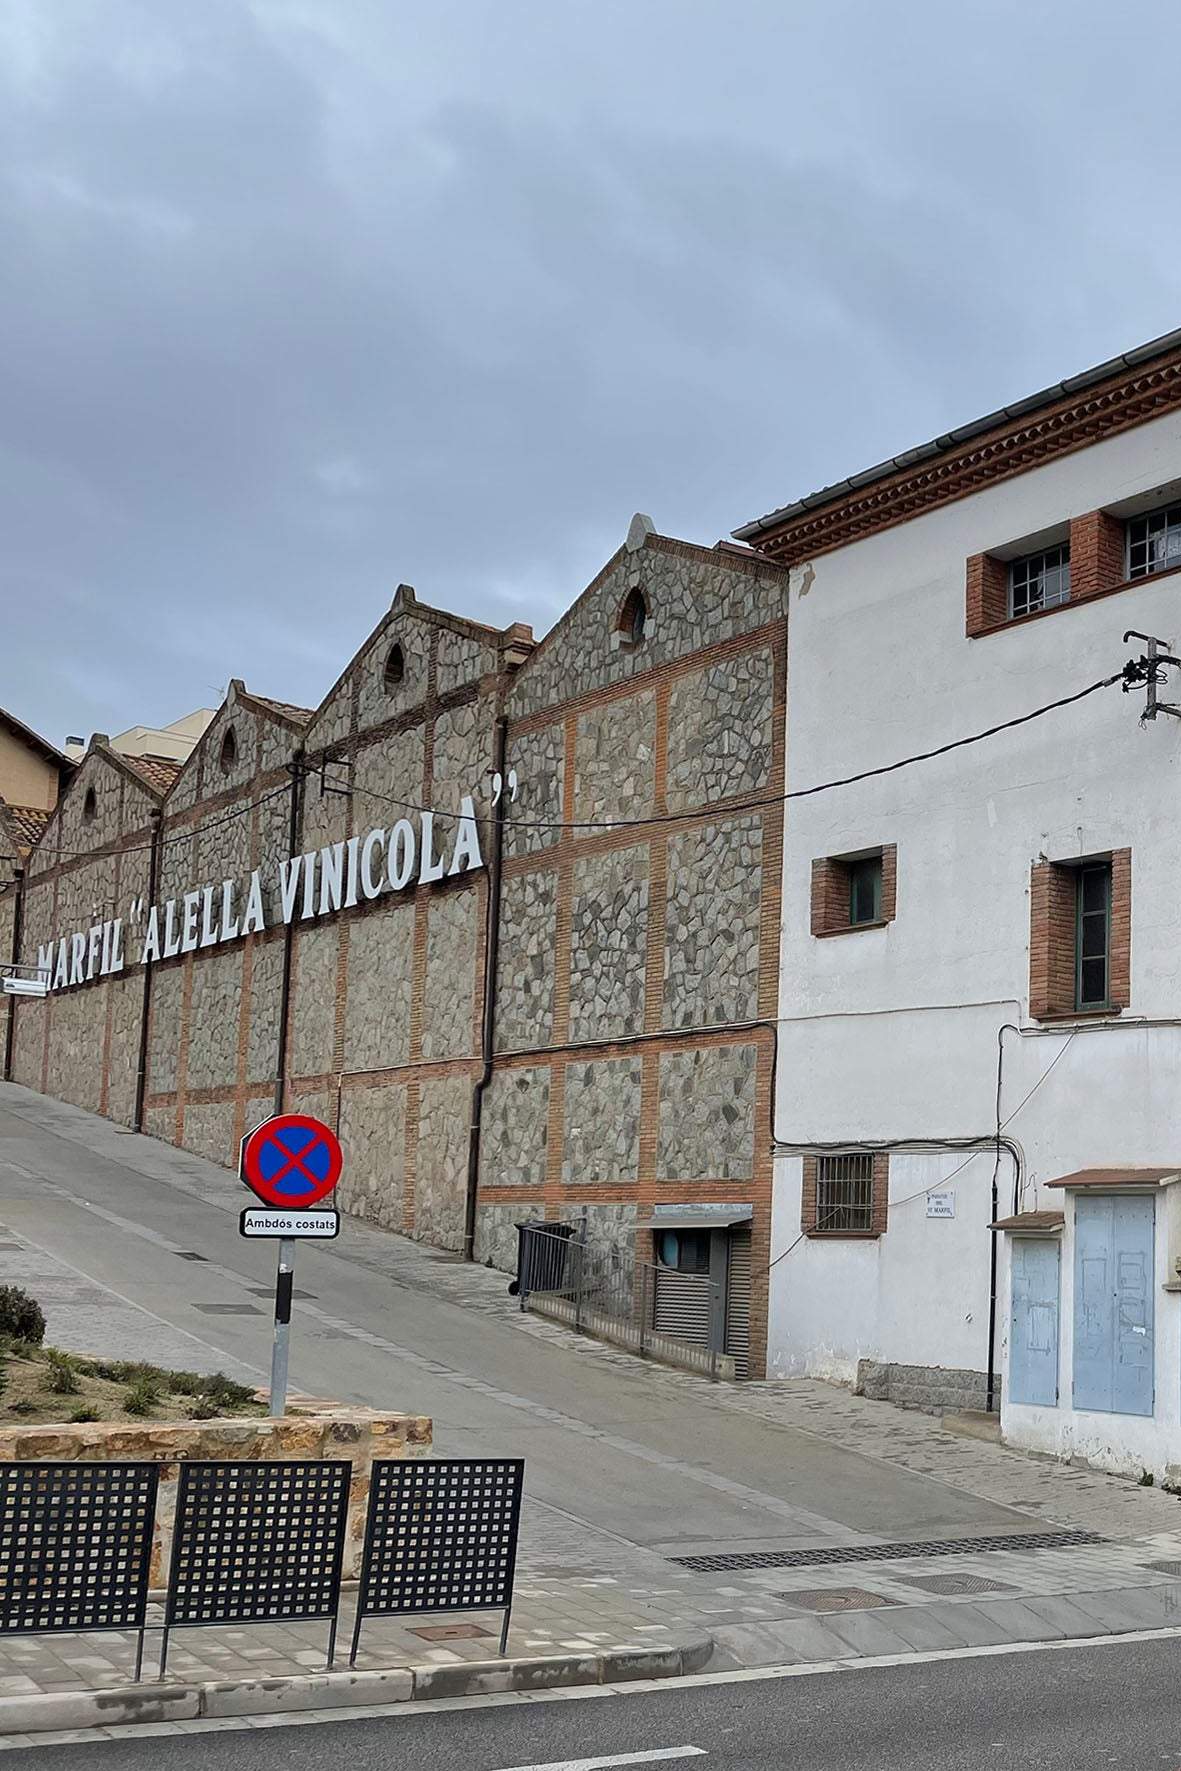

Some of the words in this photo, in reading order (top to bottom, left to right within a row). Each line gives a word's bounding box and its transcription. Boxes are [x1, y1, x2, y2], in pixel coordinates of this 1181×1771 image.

[38, 918, 124, 992] MARFIL
[245, 1218, 292, 1229] Ambdós
[296, 1219, 335, 1229] costats
